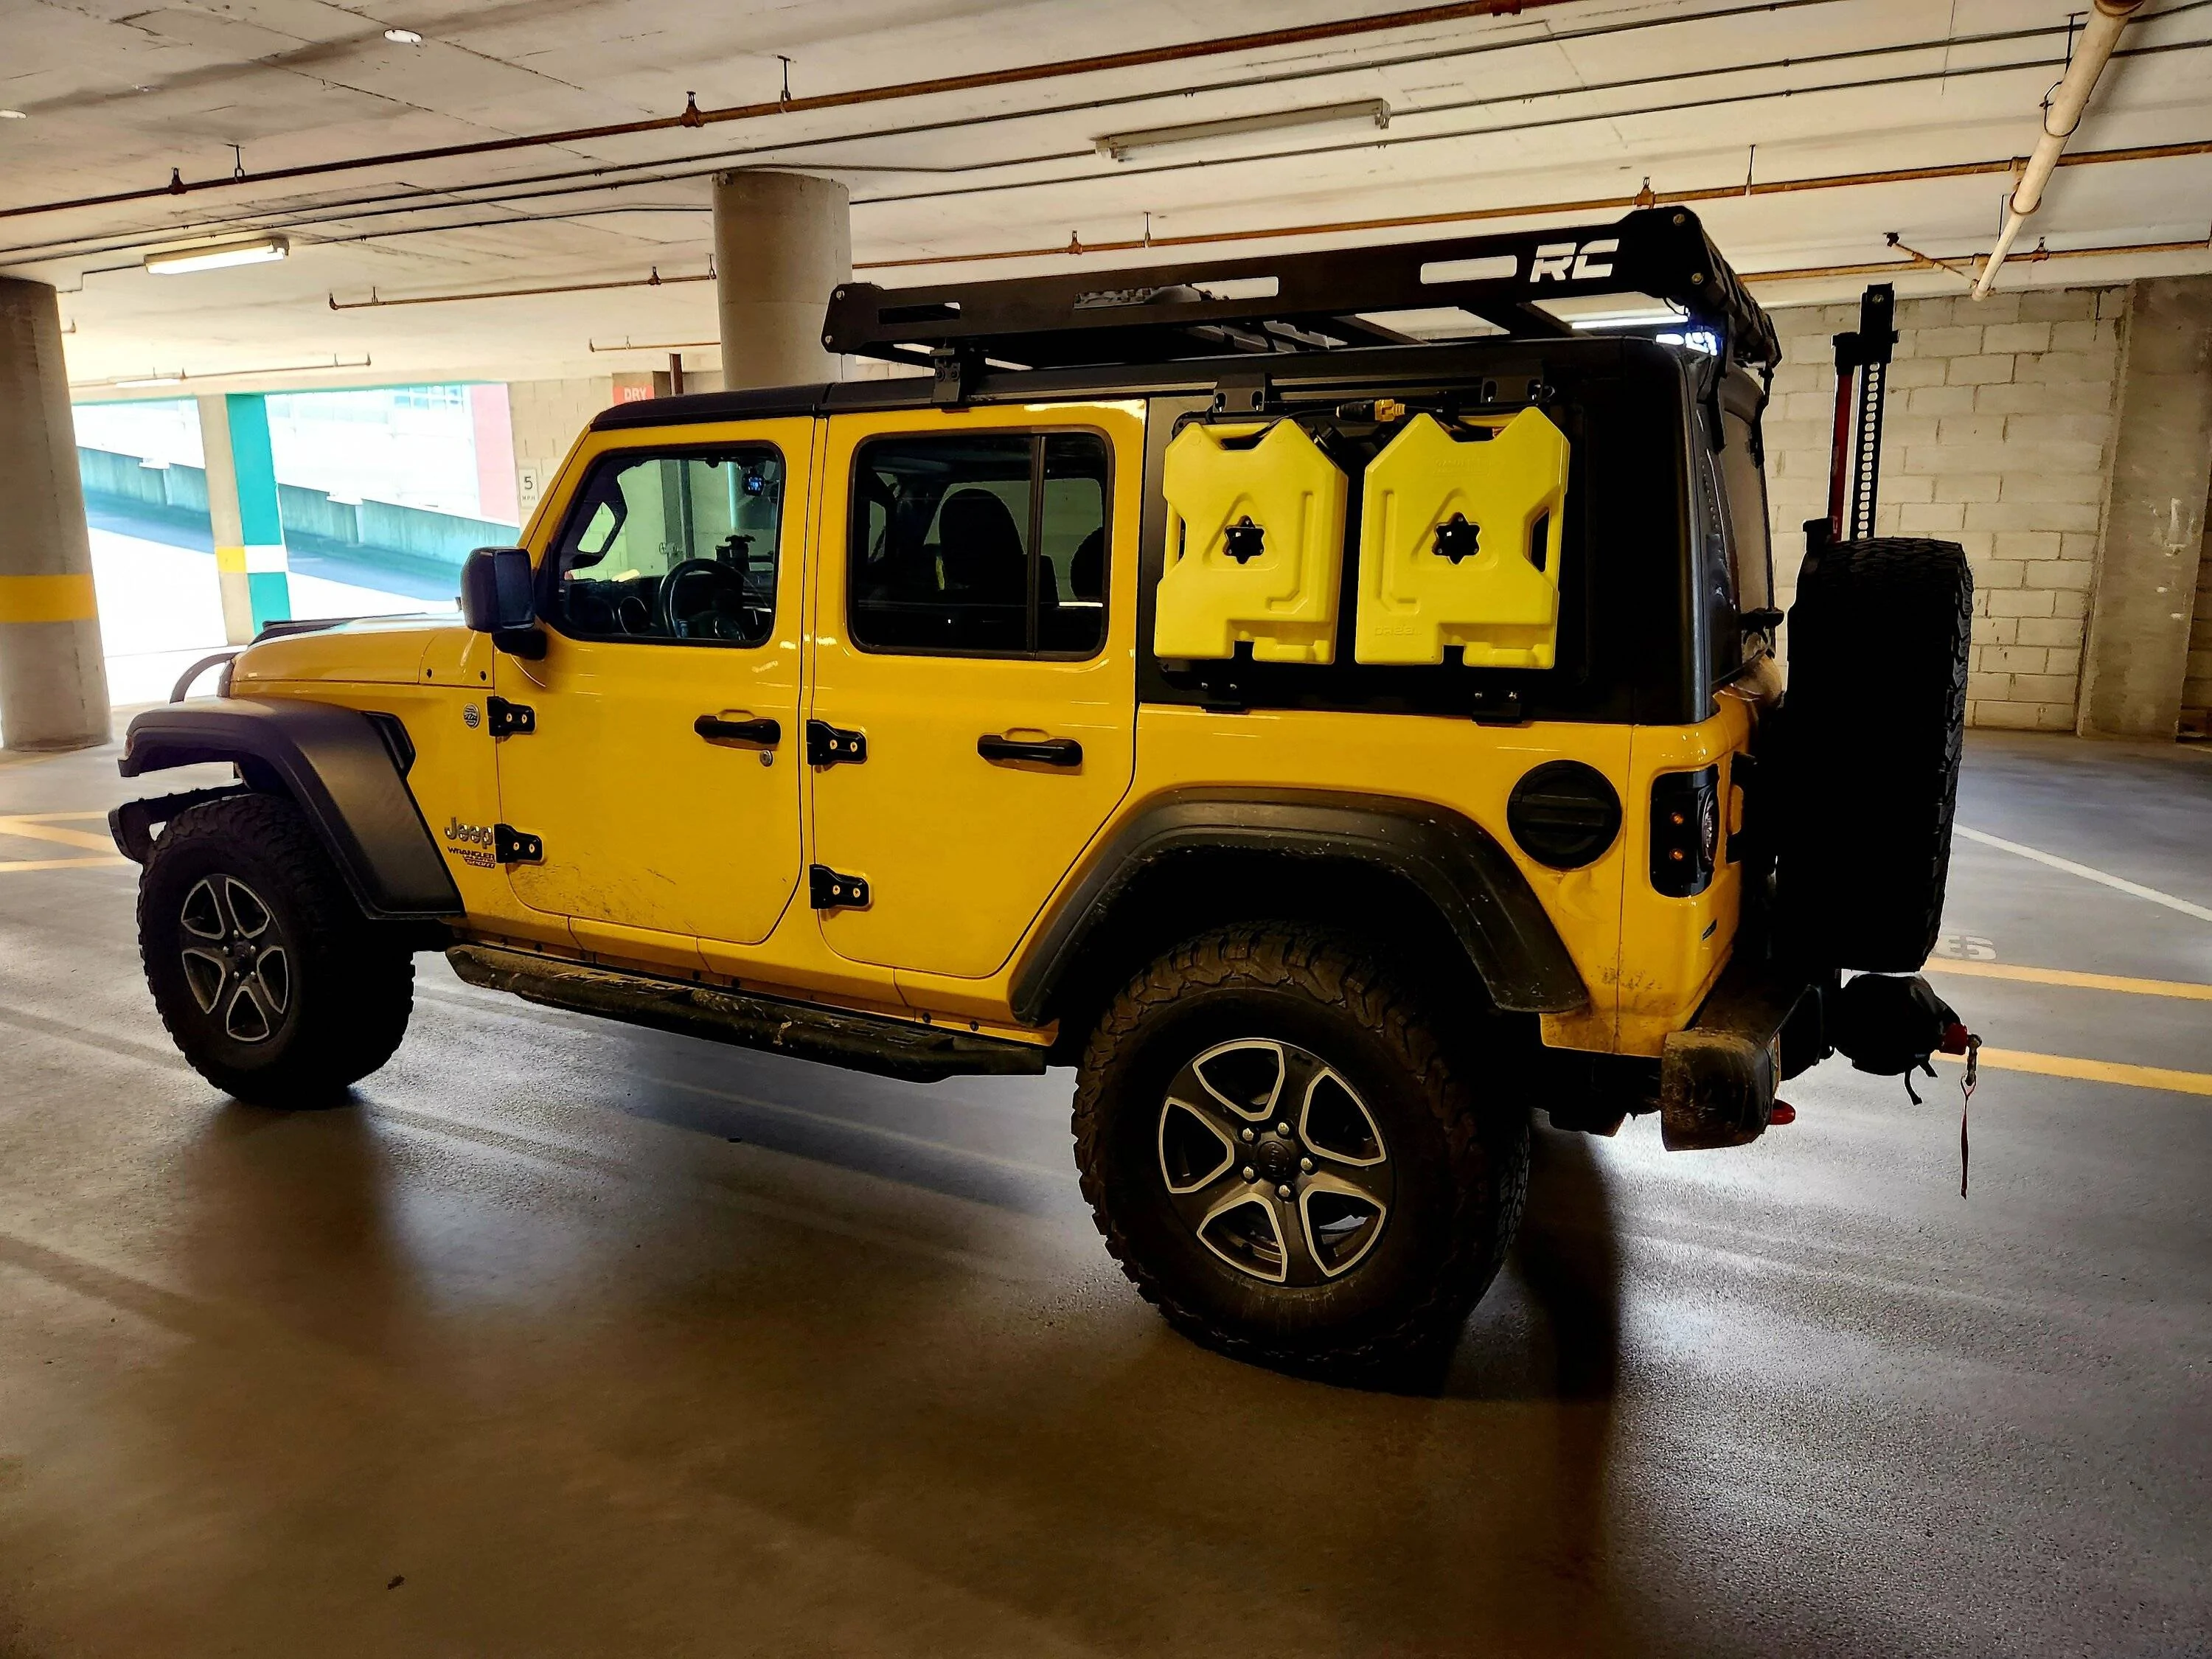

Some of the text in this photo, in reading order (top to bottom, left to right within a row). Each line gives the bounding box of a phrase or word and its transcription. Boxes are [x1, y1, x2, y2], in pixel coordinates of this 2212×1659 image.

[1530, 238, 1619, 282] RC
[624, 387, 647, 402] DRY
[524, 476, 533, 490] 5
[444, 816, 493, 849] Jeep
[448, 846, 495, 860] WRANGLER
